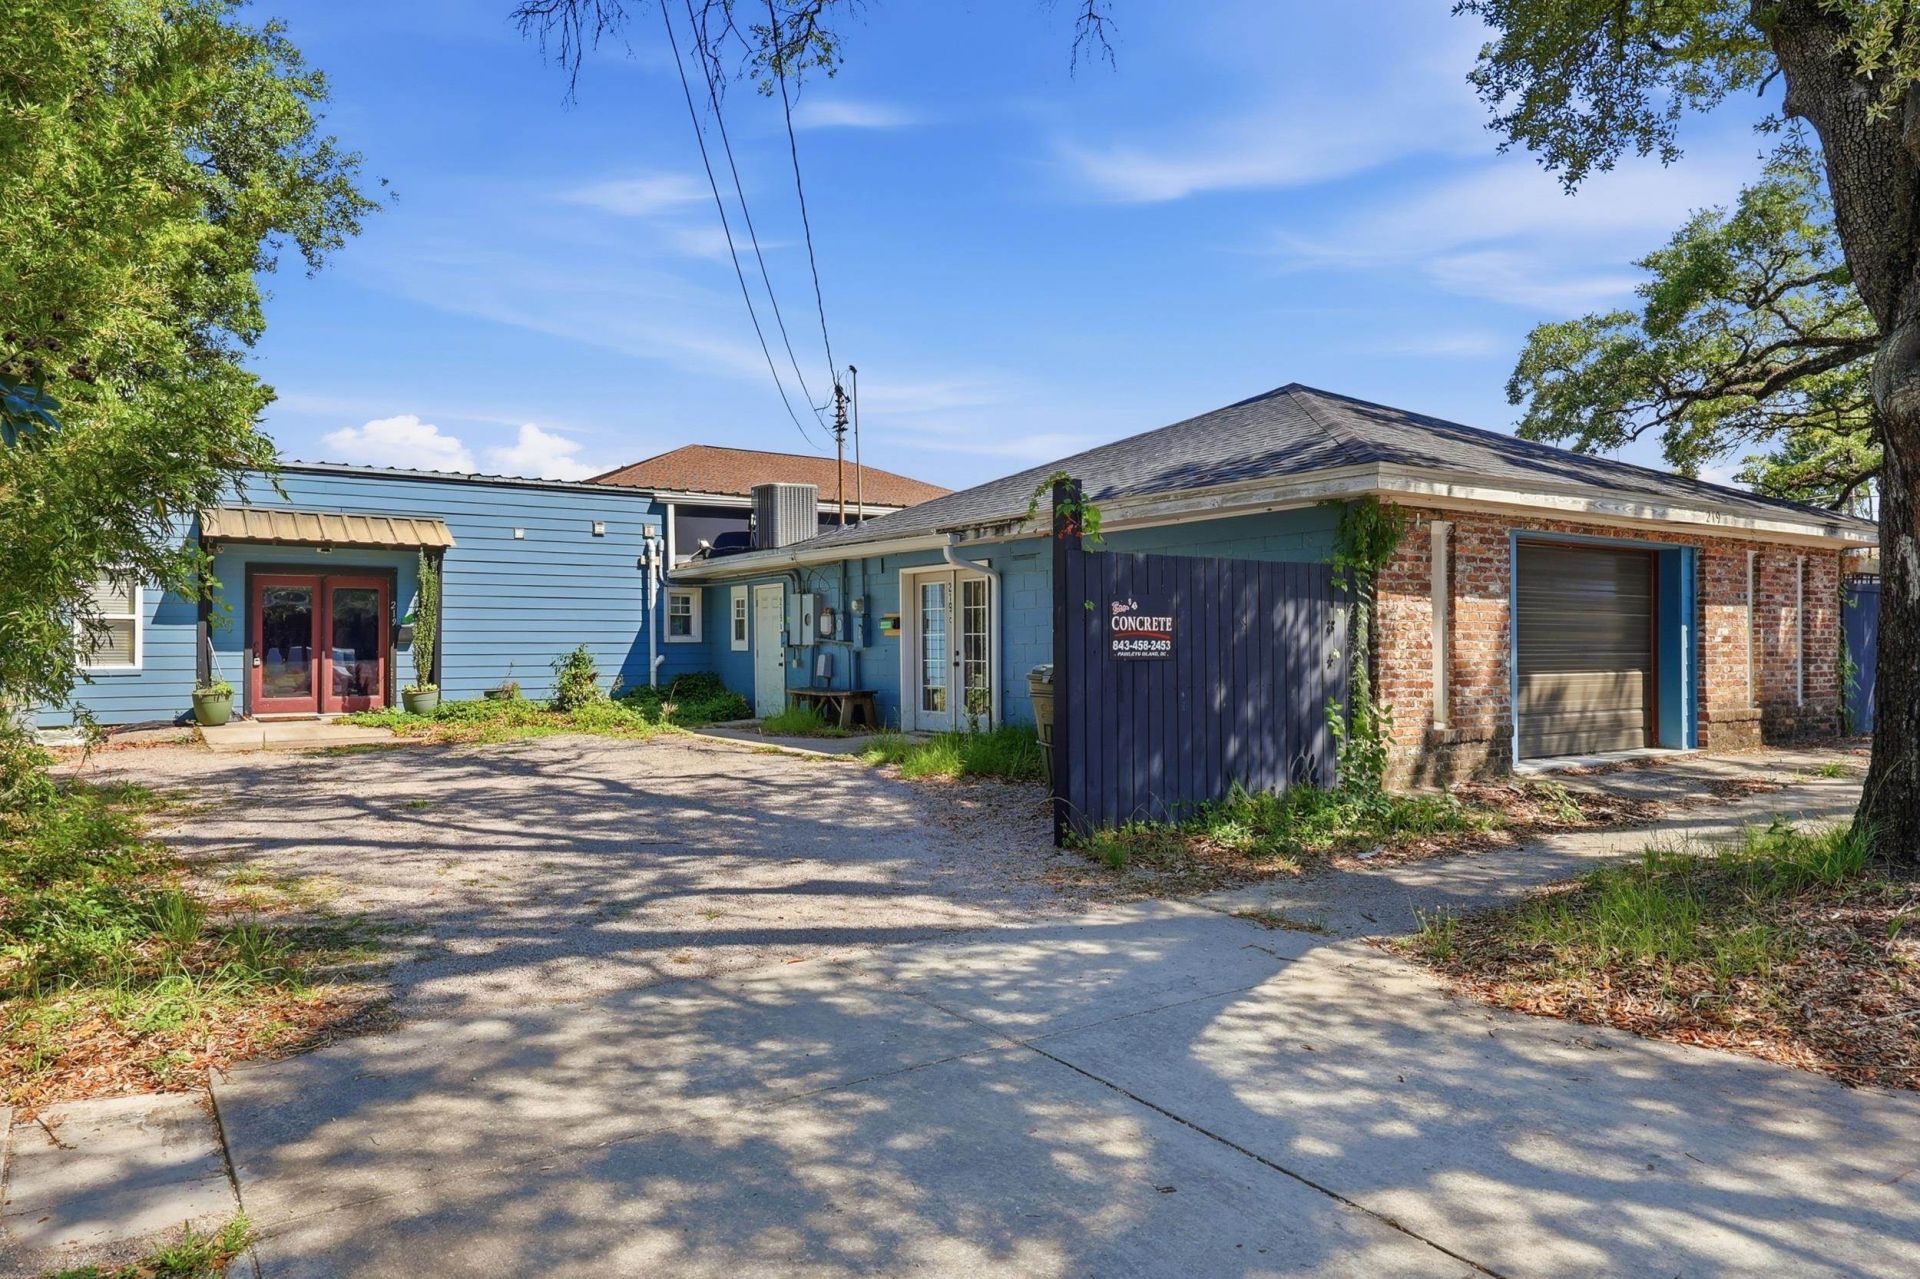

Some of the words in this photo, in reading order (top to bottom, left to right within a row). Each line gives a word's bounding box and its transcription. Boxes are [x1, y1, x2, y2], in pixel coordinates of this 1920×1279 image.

[1706, 510, 1720, 524] 219
[1112, 616, 1173, 632] CONCRETE
[1112, 640, 1172, 651] 843-458-2453
